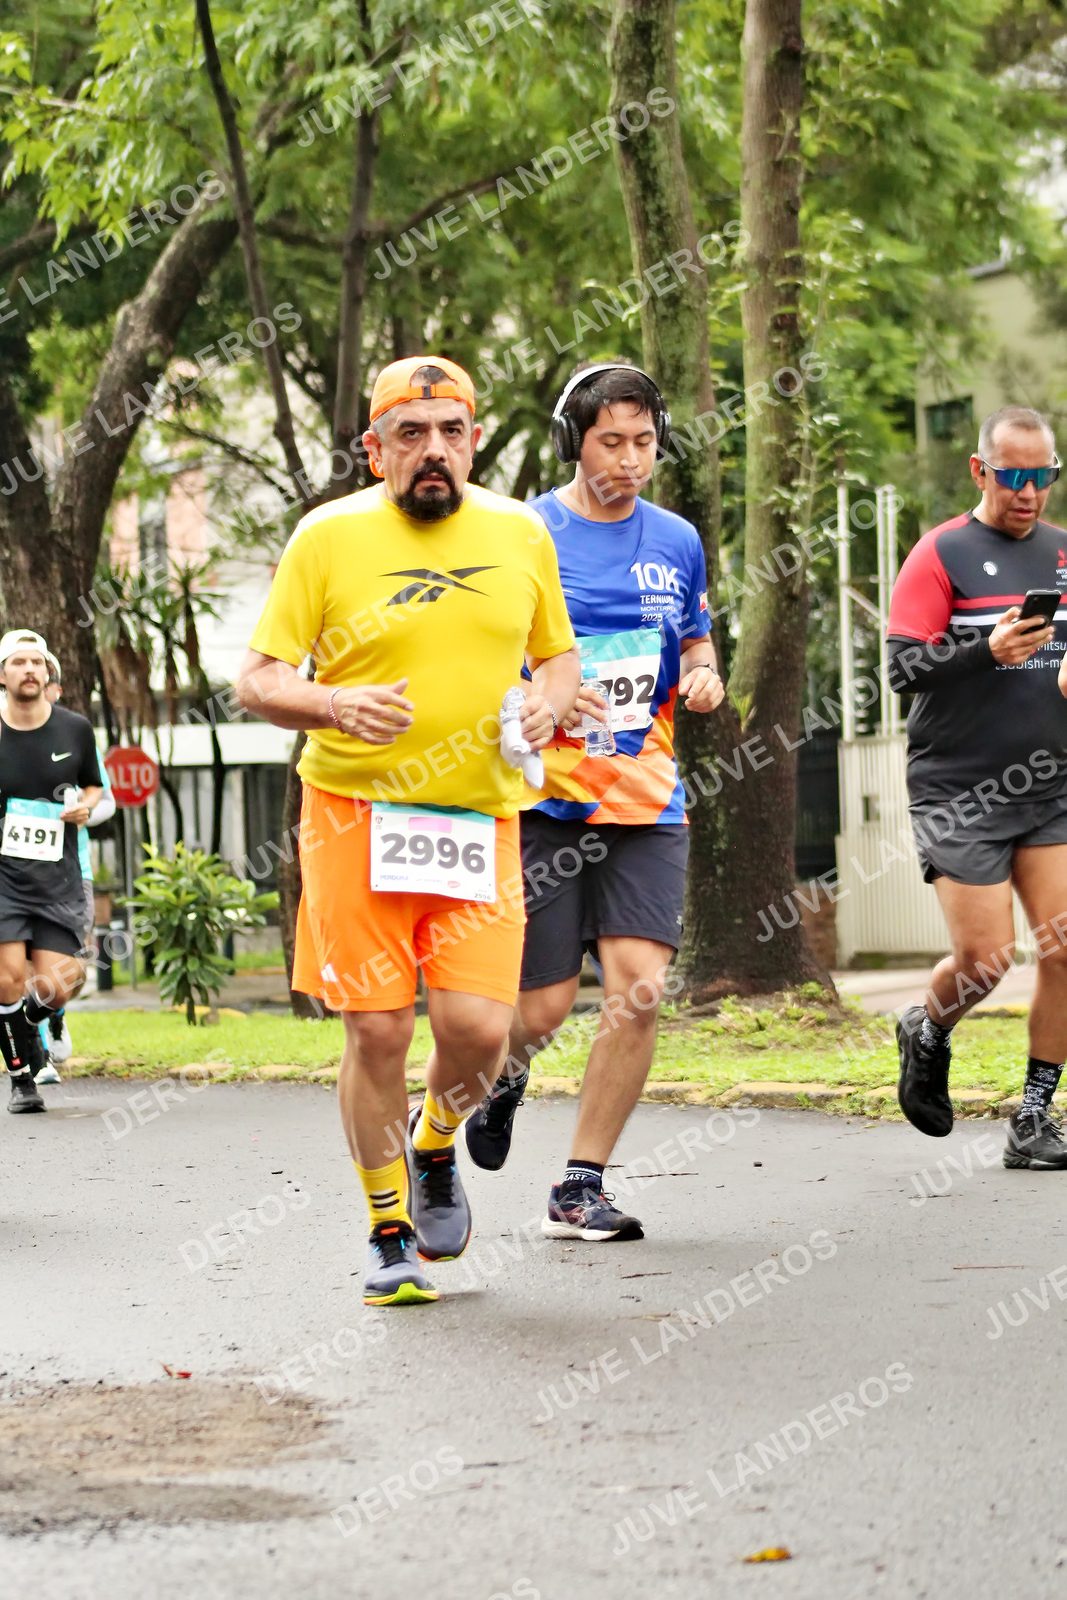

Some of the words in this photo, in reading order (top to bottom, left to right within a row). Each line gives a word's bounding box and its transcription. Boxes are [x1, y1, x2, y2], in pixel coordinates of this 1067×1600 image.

[630, 562, 680, 593] 10K
[640, 613, 663, 622] 2025
[995, 658, 1063, 671] ishi-m
[580, 674, 655, 706] 792
[8, 826, 57, 847] 4191
[380, 832, 486, 874] 2996
